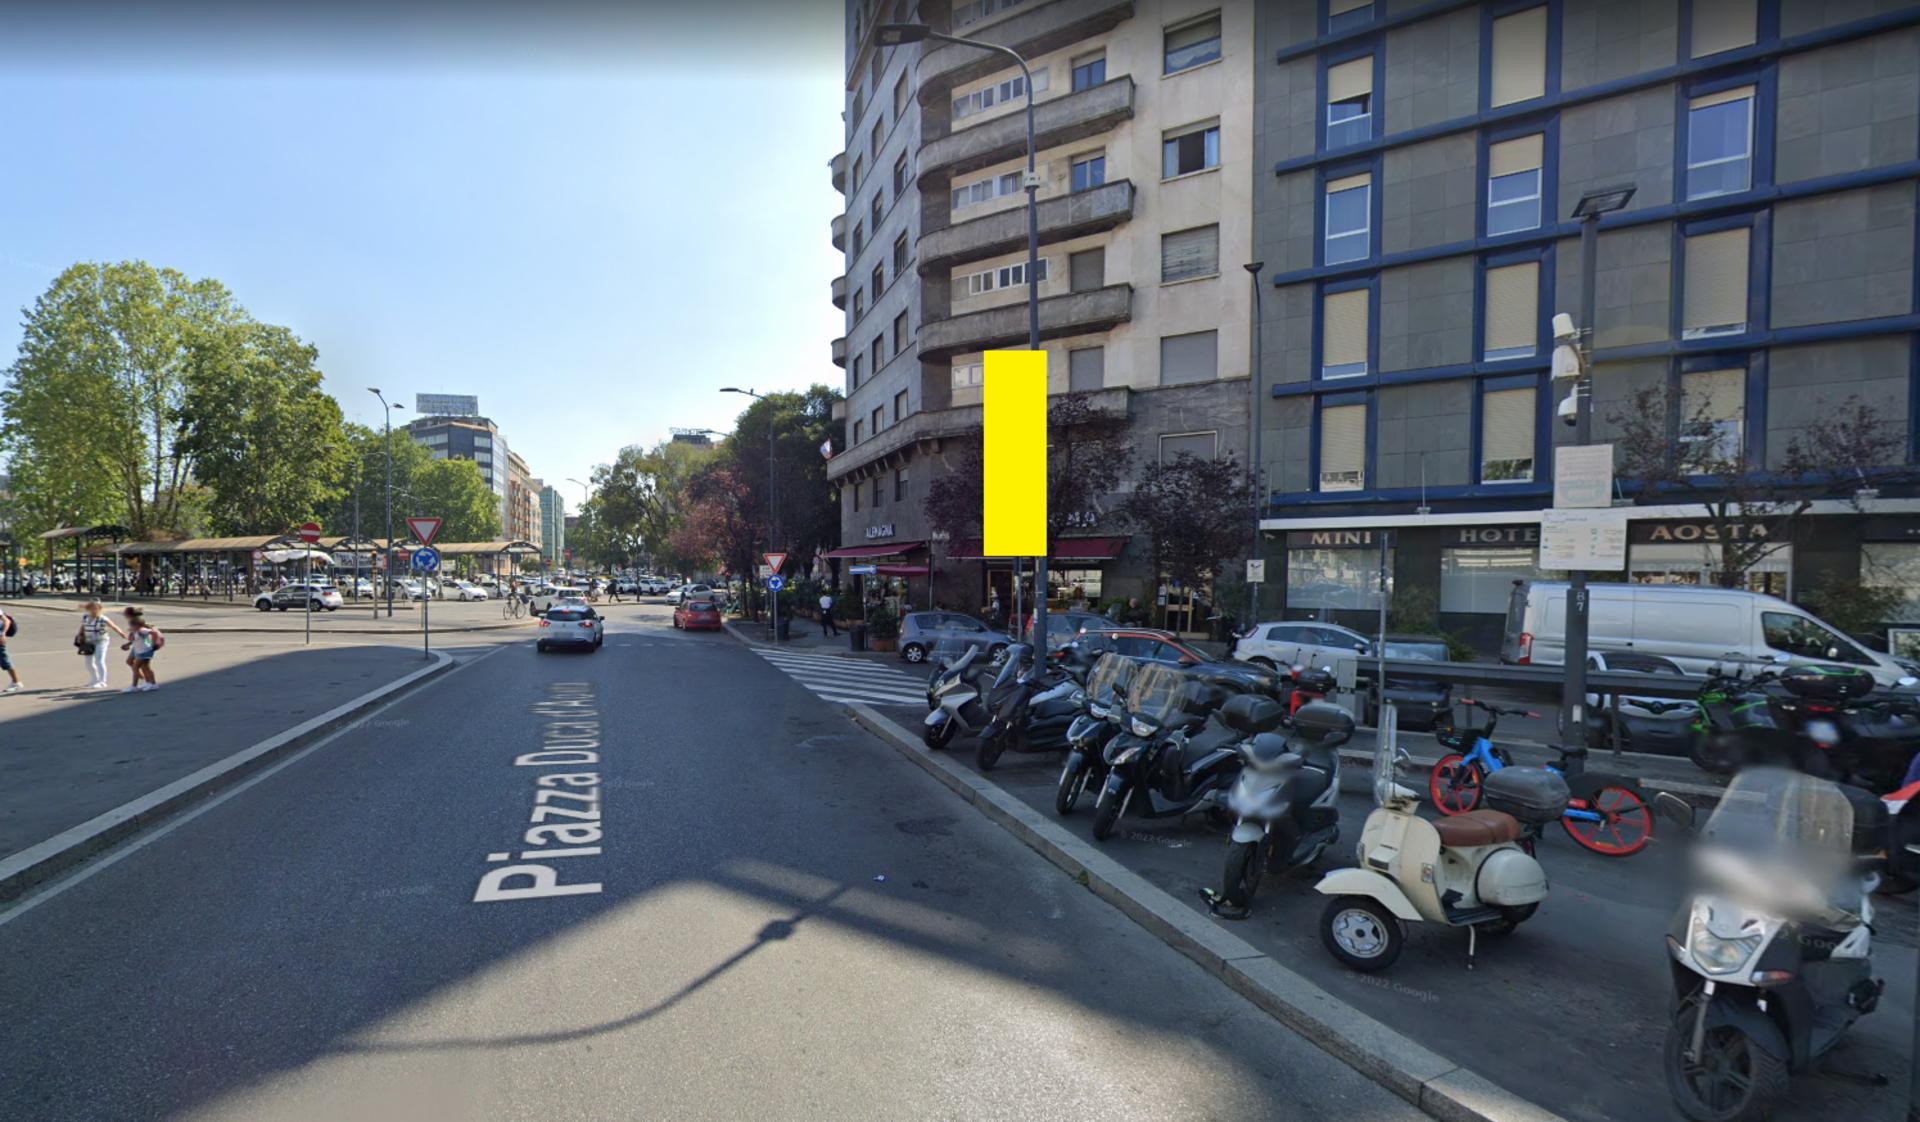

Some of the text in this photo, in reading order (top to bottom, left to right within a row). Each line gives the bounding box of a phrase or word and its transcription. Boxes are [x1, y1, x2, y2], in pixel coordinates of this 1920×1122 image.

[1310, 523, 1769, 545] MINI HOTE AOSTA
